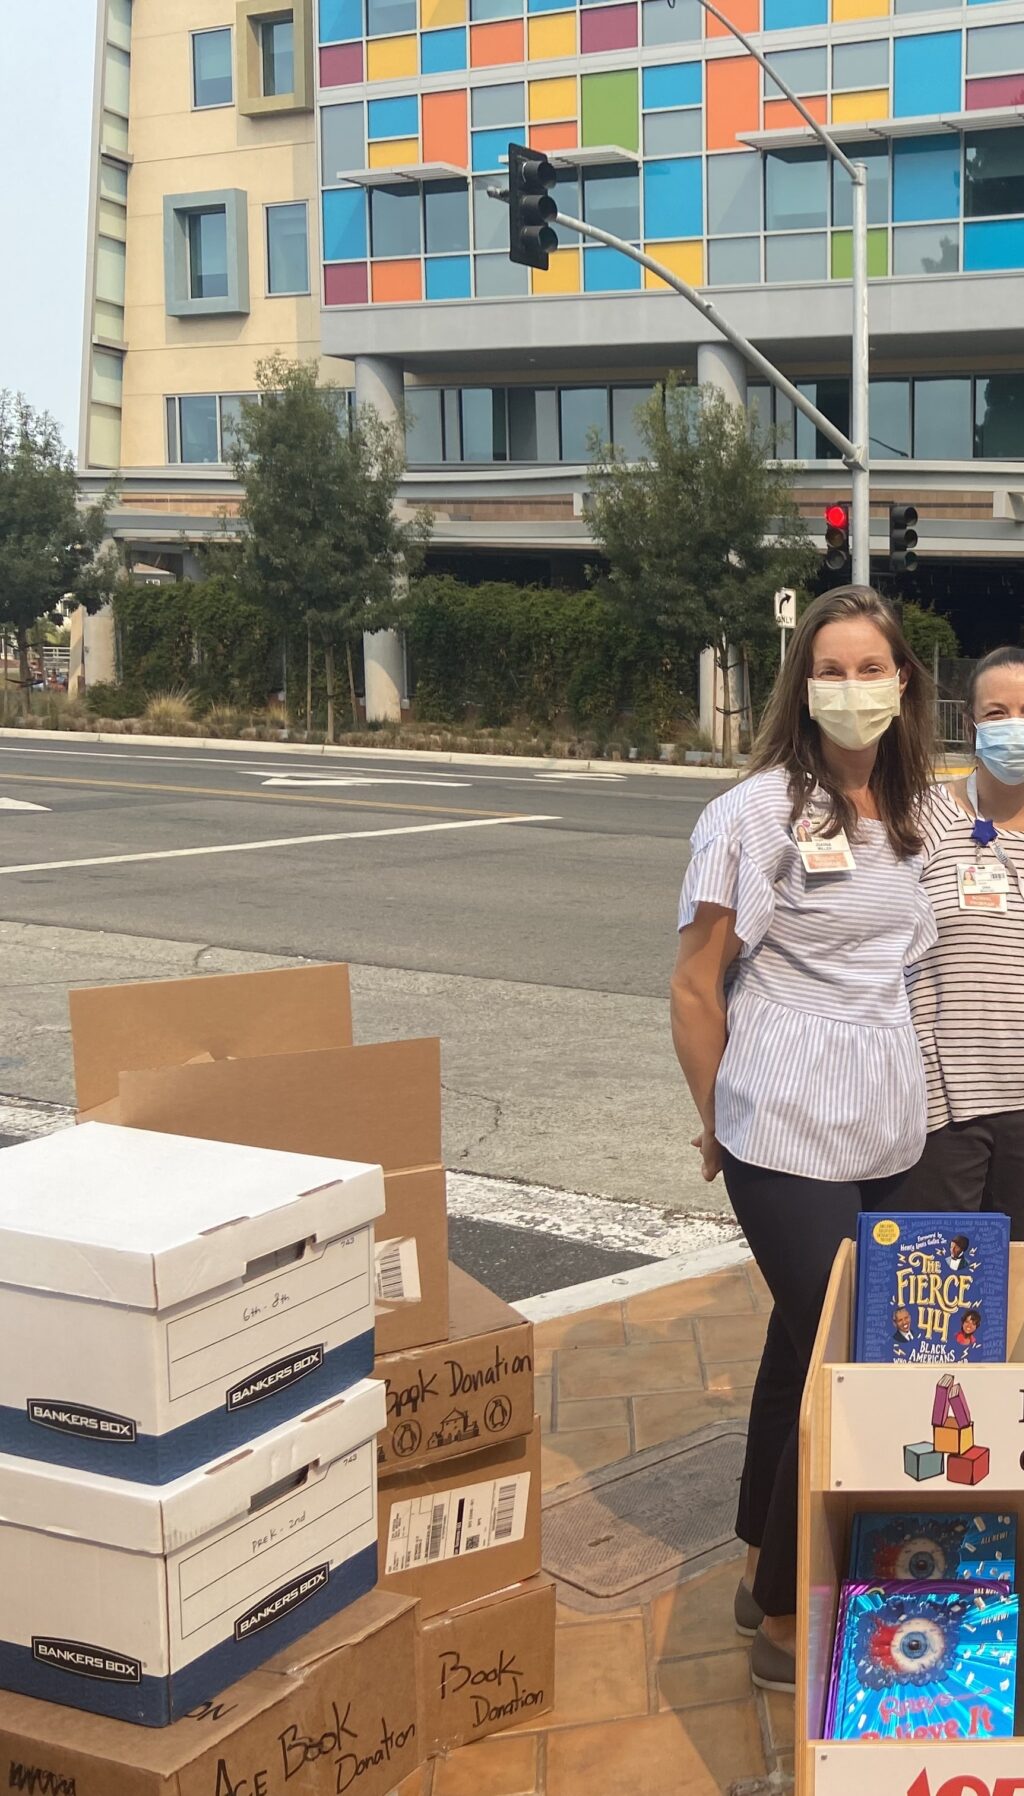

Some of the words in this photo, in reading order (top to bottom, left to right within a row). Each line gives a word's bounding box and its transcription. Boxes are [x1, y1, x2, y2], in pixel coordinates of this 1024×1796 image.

[775, 616, 793, 624] ONLY
[908, 1251, 942, 1274] THE
[896, 1267, 973, 1313] FIERCE
[917, 1307, 951, 1343] 44
[908, 1348, 956, 1363] AMERICANS
[919, 1341, 946, 1355] BLACK
[232, 1369, 291, 1404] BANKERS
[293, 1351, 319, 1372] BOX
[444, 1345, 532, 1397] Donation
[33, 1406, 98, 1429] BANKERS
[100, 1420, 130, 1435] BOX
[981, 1537, 991, 1545] ALL
[993, 1531, 1008, 1540] NEW!
[240, 1588, 299, 1633] BANKERS
[300, 1570, 325, 1593] BOX
[981, 1616, 991, 1625] ALL
[37, 1644, 103, 1669] BANKERS
[105, 1659, 136, 1677] BOX
[438, 1650, 523, 1699] Book
[470, 1676, 544, 1729] Donation
[278, 1702, 357, 1782] Book
[335, 1717, 415, 1794] Donation
